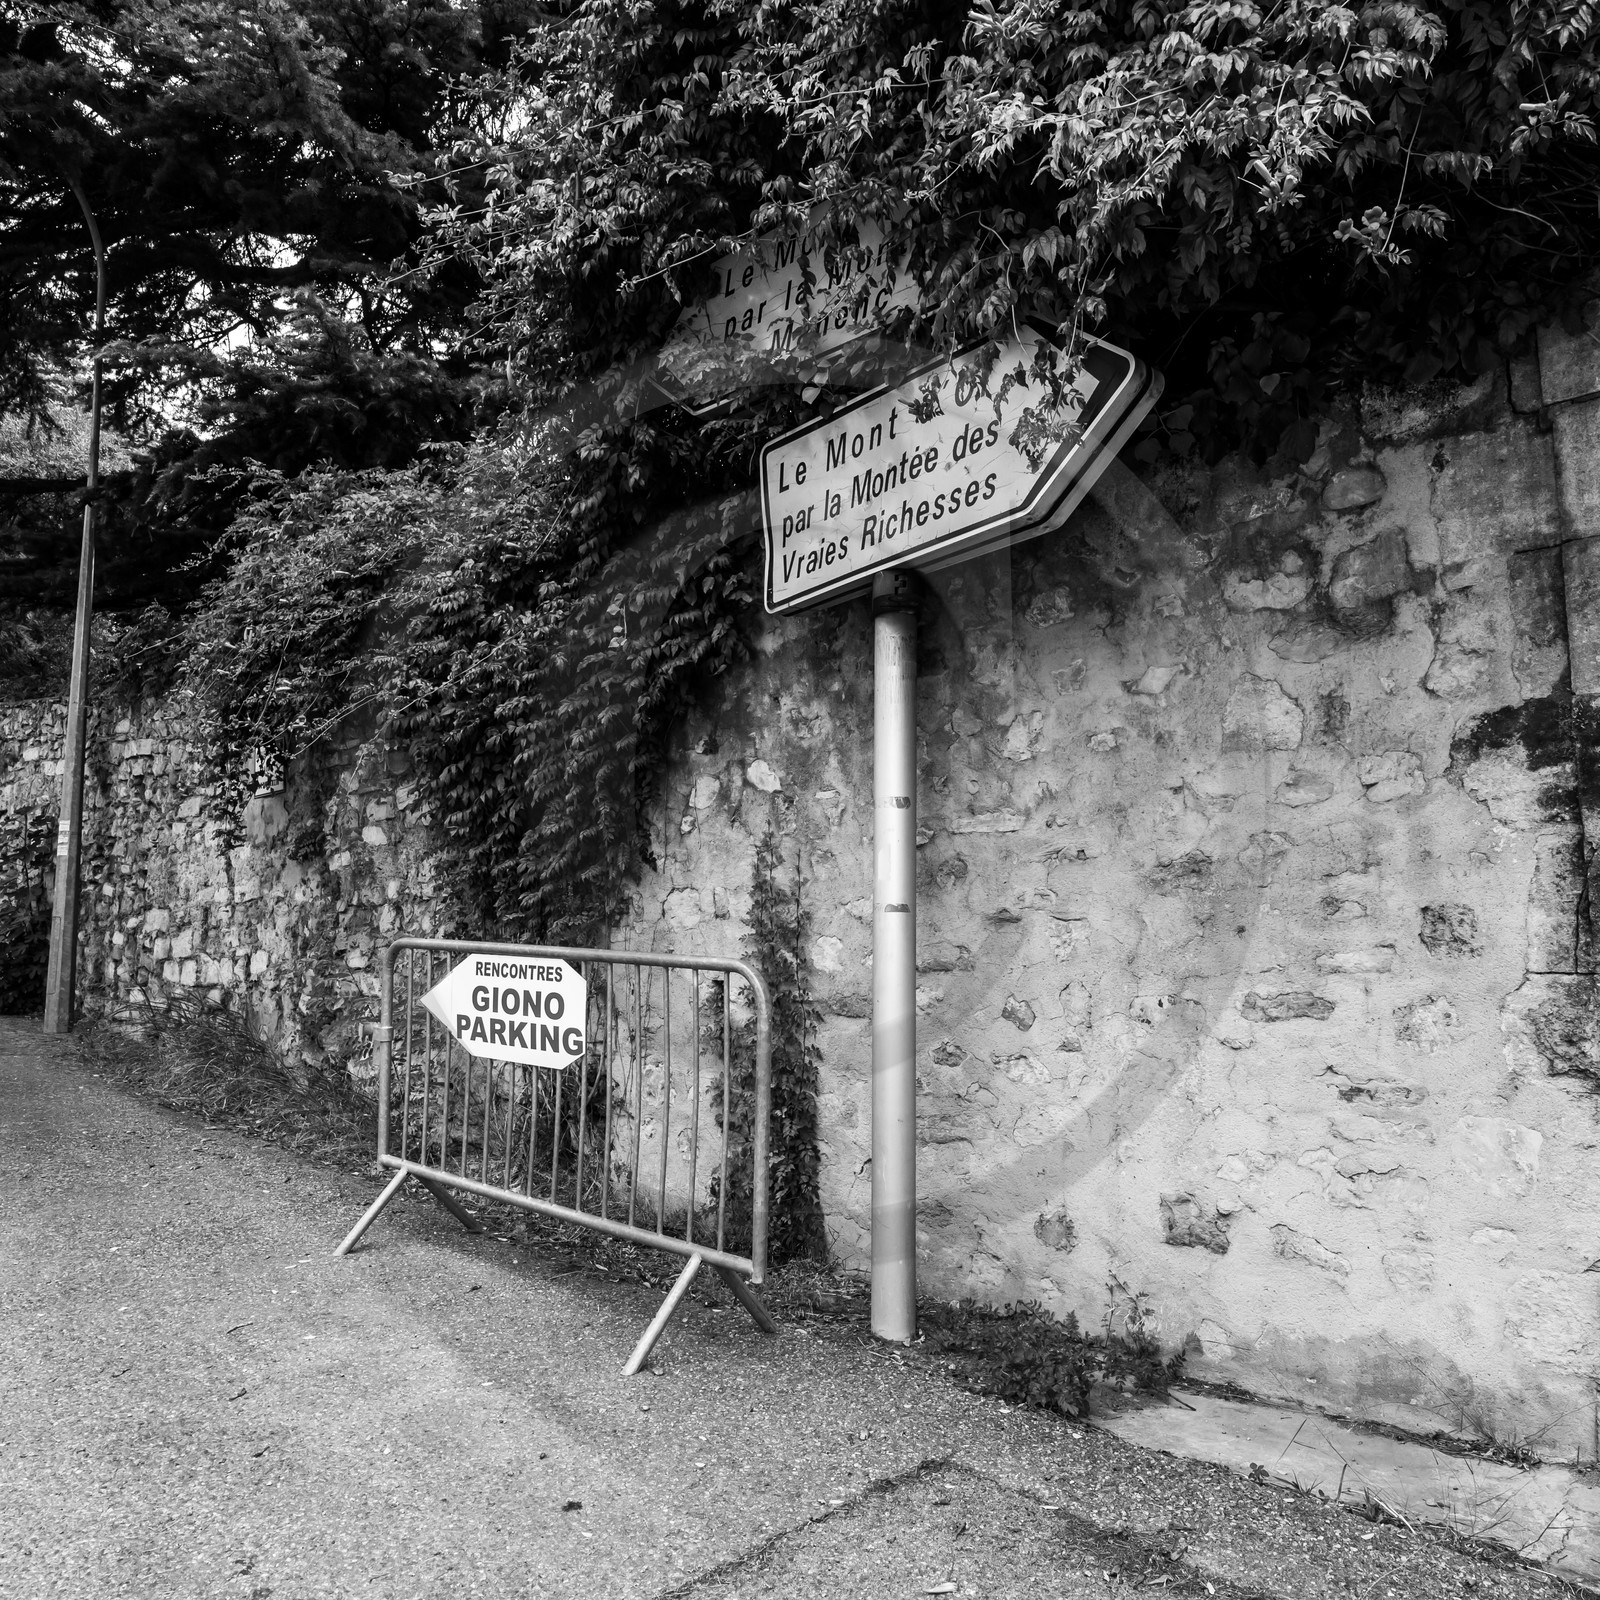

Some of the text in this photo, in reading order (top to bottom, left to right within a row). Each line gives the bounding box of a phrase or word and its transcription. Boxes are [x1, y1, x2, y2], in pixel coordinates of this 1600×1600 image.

[724, 264, 754, 298] Le
[724, 300, 767, 343] par
[777, 461, 807, 494] Le
[826, 407, 899, 472] Mont
[782, 418, 1000, 548] par la Montée des
[781, 472, 998, 584] Vraies Richesses
[475, 961, 563, 983] RENCONTRES
[471, 985, 565, 1021] GIONO
[456, 1013, 584, 1057] PARKING
